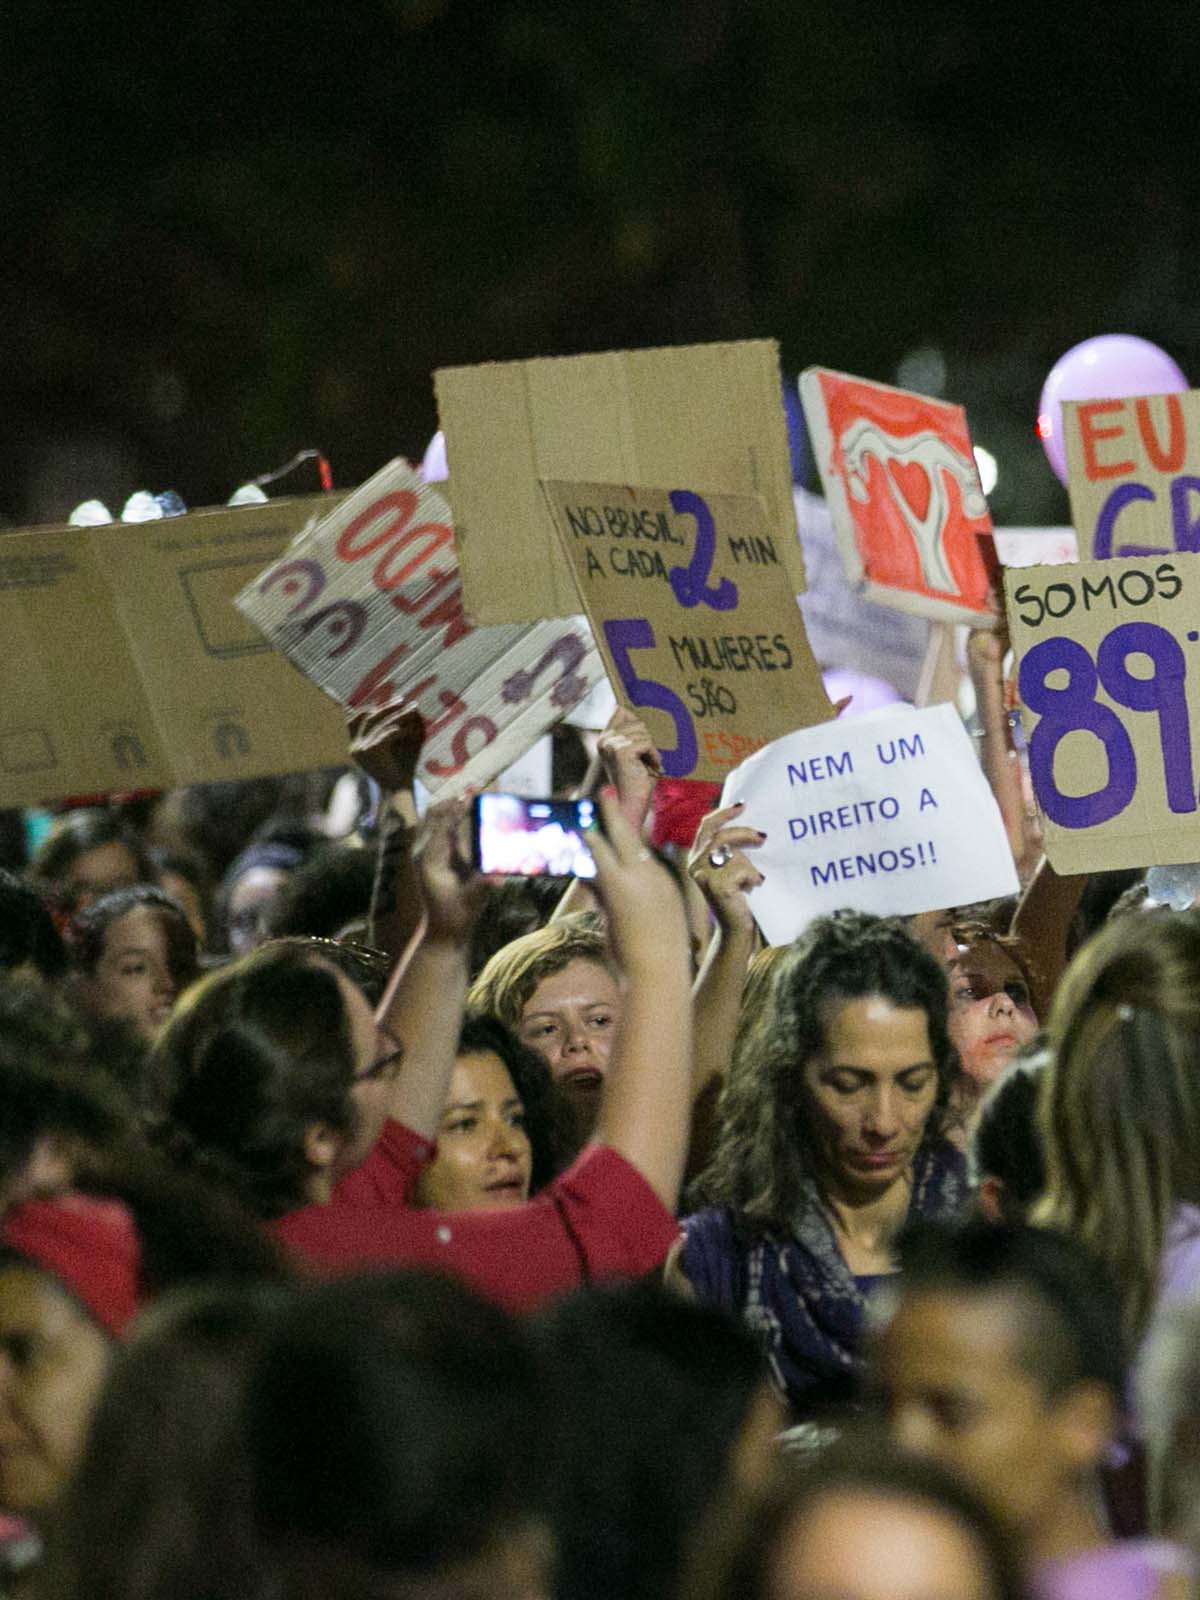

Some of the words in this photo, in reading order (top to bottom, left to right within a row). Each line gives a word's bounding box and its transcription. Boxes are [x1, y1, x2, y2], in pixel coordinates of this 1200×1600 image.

[1076, 393, 1187, 482] EU
[565, 506, 600, 539] NO
[585, 547, 606, 578] A
[609, 547, 671, 583] CADA
[668, 489, 739, 611] 2
[728, 535, 779, 565] MIN
[1014, 563, 1183, 627] SOMOS
[603, 618, 699, 778] 5
[668, 634, 793, 672] MULHERES
[687, 677, 736, 718] SÃO
[787, 752, 853, 787] NEM
[876, 733, 925, 765] UM
[788, 797, 899, 840] DIREITO
[919, 788, 938, 812] A
[810, 841, 937, 886] MENOS!!
